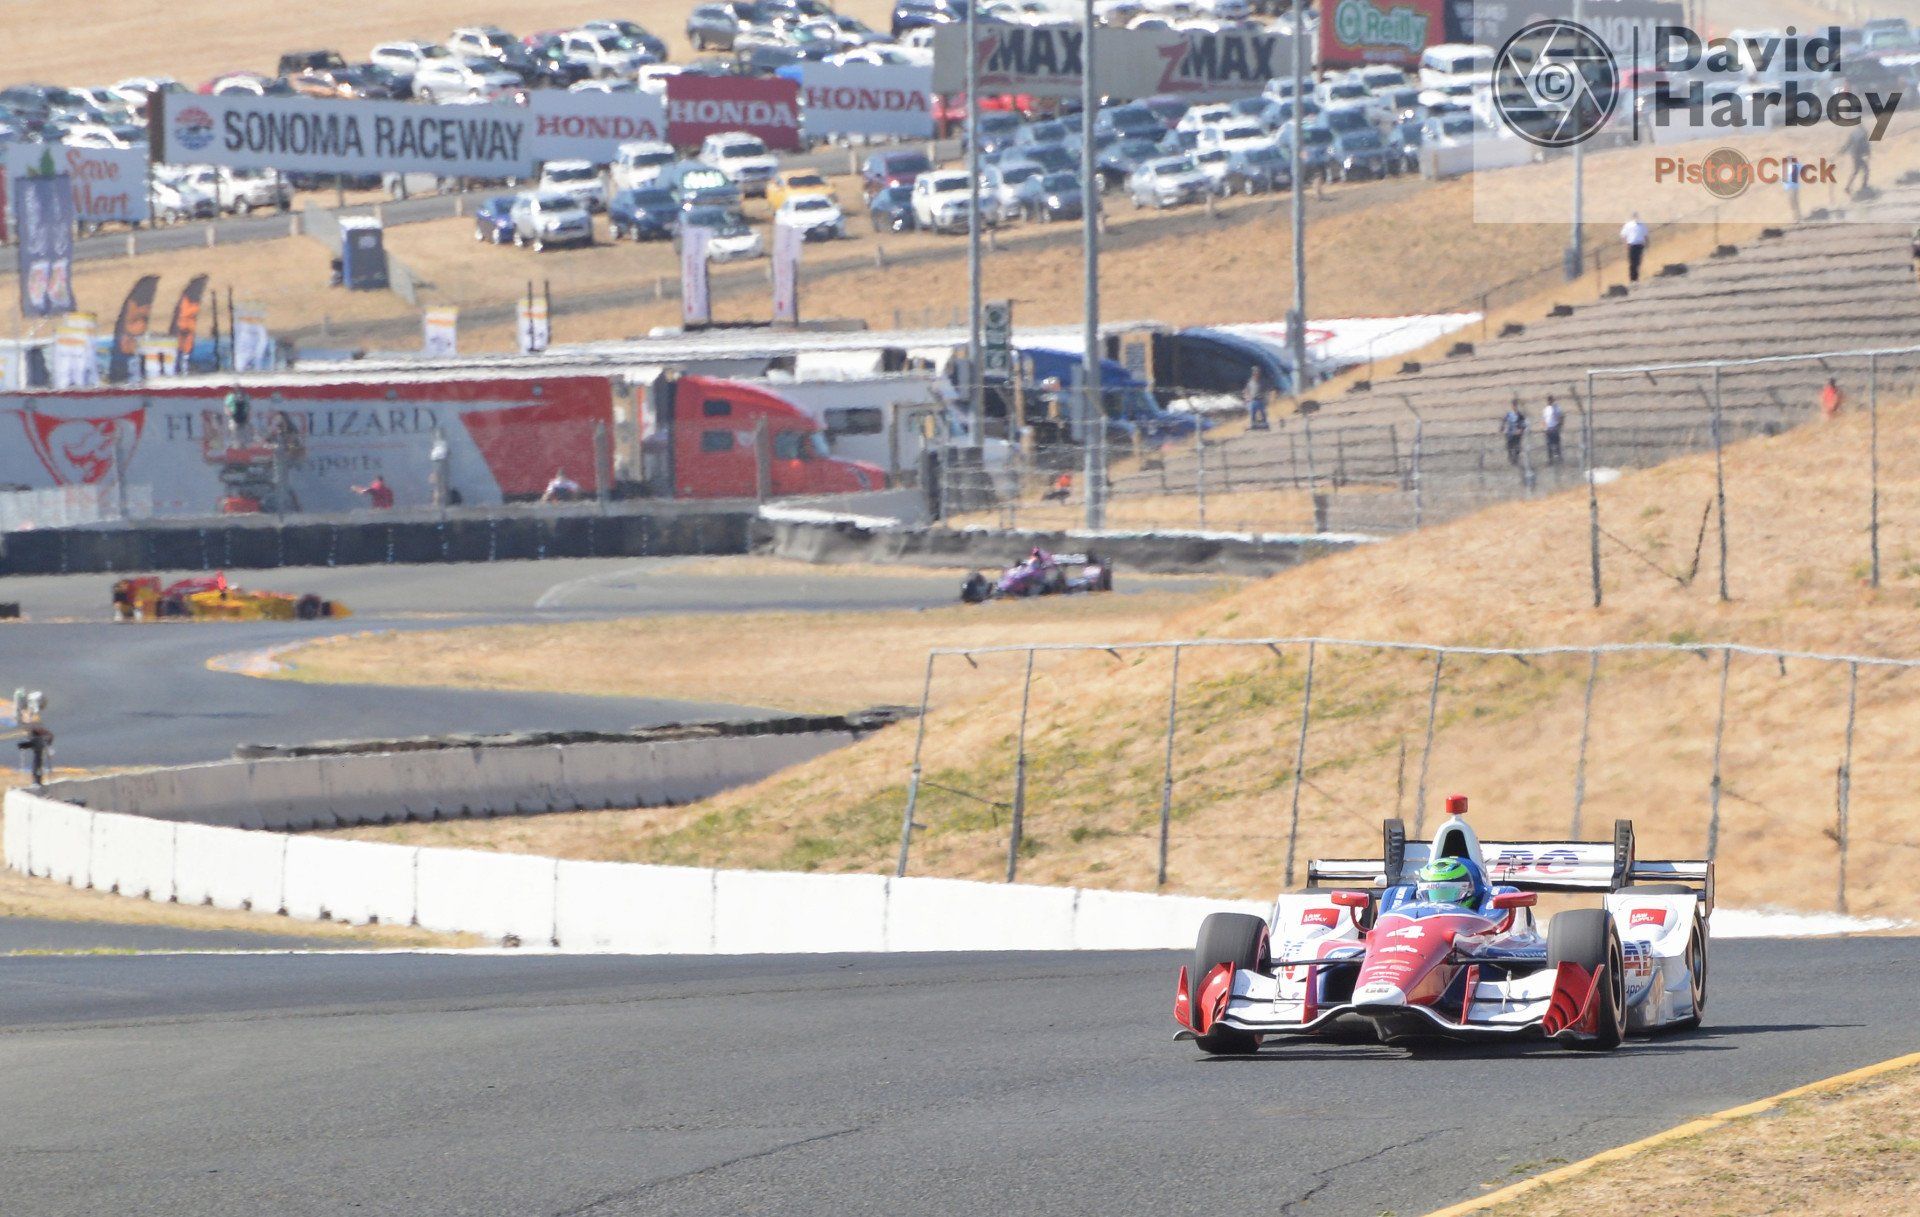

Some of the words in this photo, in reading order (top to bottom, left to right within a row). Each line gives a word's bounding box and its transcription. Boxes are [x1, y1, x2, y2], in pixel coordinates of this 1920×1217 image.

[670, 99, 796, 127] HONDA
[806, 87, 929, 113] HONDA
[223, 110, 365, 158] SONOMA
[375, 115, 525, 162] RACEWAY
[535, 113, 659, 140] HONDA
[308, 408, 438, 437] LIZARD
[1385, 925, 1426, 939] 4
